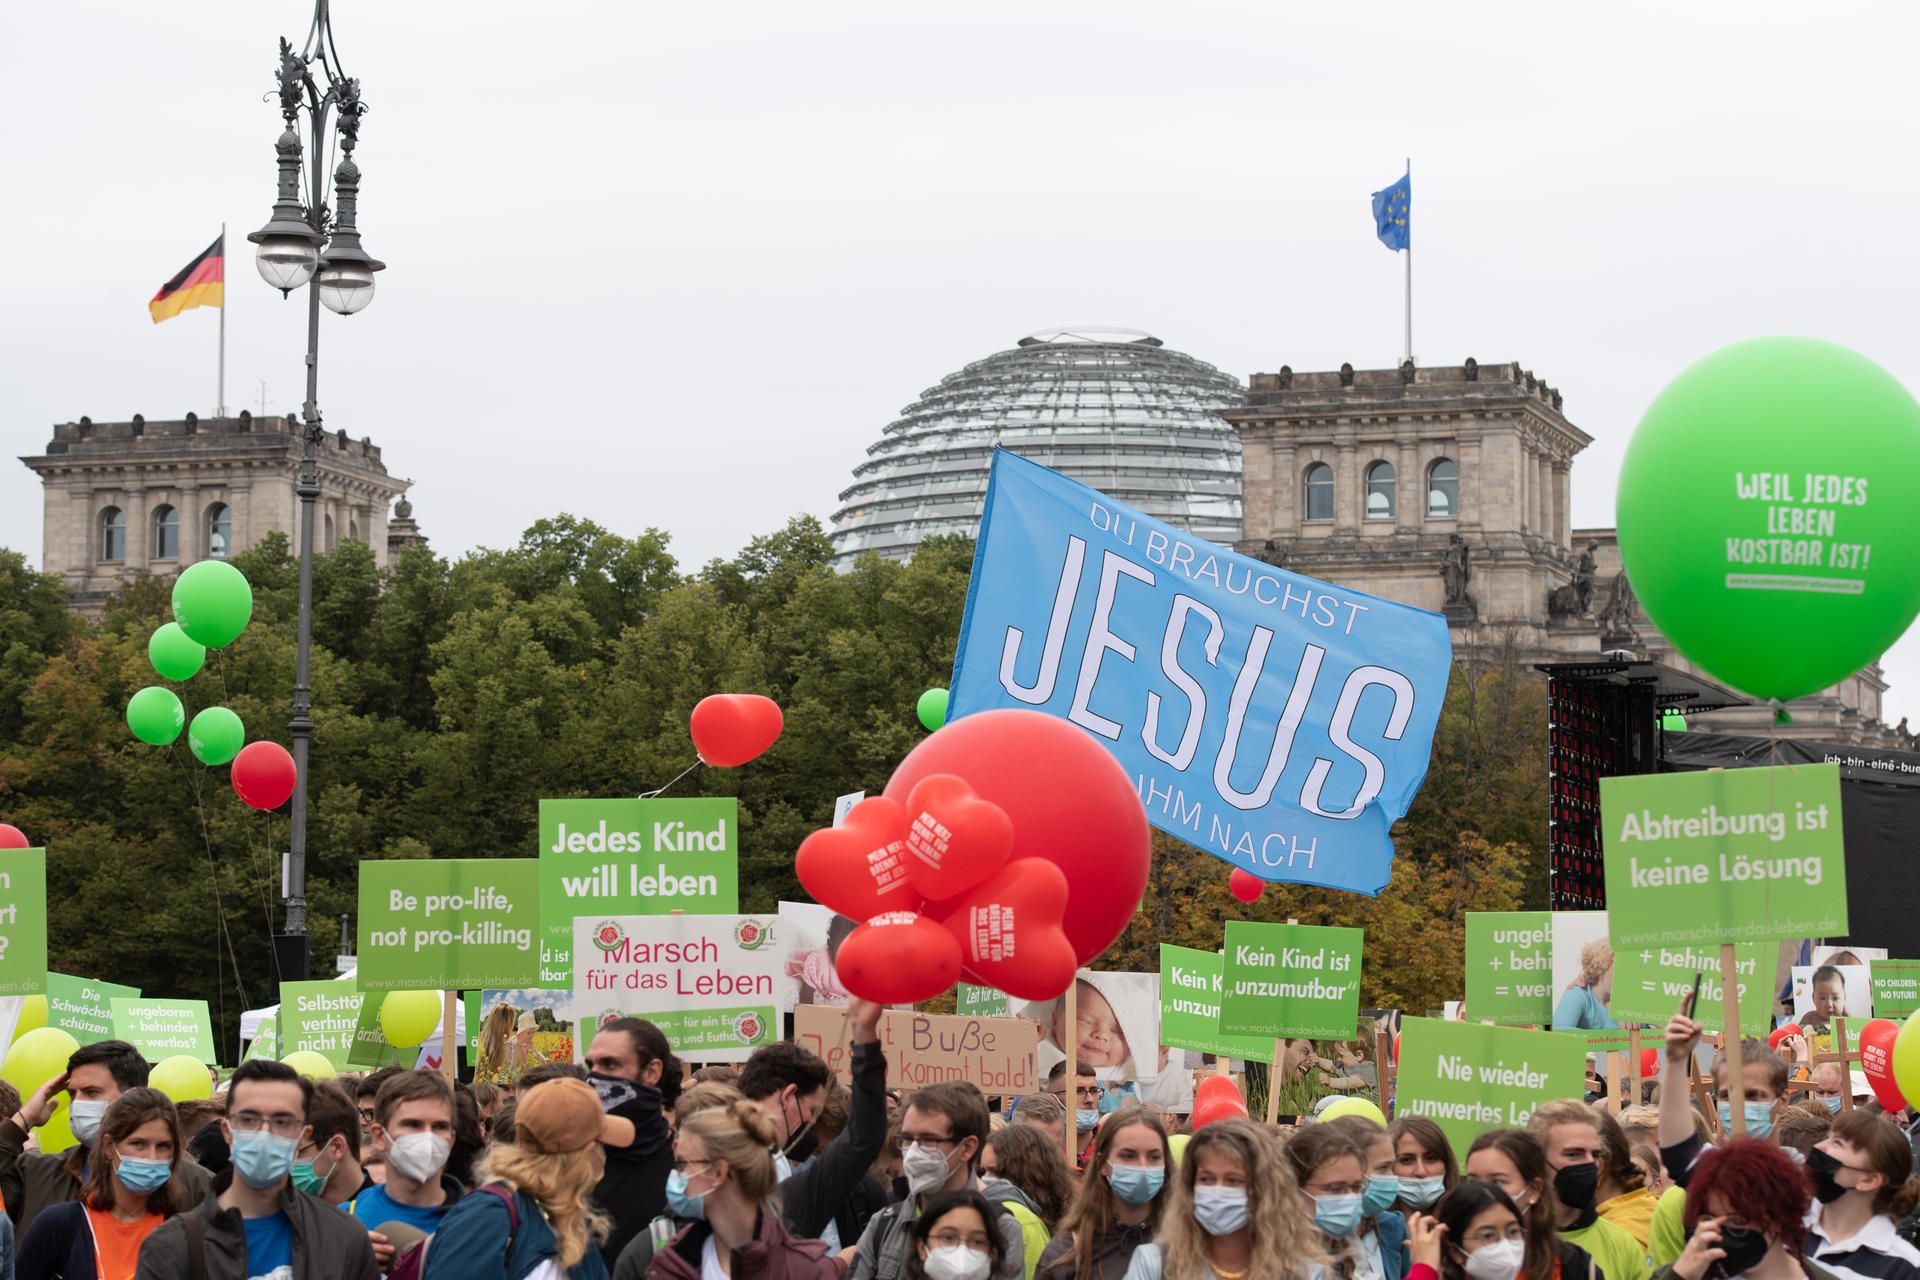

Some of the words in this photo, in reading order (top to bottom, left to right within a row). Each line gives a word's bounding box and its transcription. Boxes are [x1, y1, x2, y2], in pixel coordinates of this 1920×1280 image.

[1736, 472, 1794, 502] WEIL
[1802, 473, 1868, 506] JEDES
[1767, 505, 1836, 537] LEBEN
[1726, 537, 1822, 566] KOSTBAR
[1829, 543, 1872, 570] IST!
[1089, 501, 1135, 547] DU
[1146, 530, 1369, 636] BRAUCHST
[999, 534, 1415, 820] JESUS
[1137, 773, 1202, 832] IHM
[1209, 813, 1318, 870] NACH
[1620, 804, 1786, 842] Abtreibung
[1796, 802, 1829, 830] ist
[551, 820, 642, 854] Jedes
[654, 819, 726, 852] Kind
[561, 864, 618, 898] will
[630, 863, 718, 897] leben
[1630, 856, 1710, 888] keine
[1719, 853, 1823, 886] Lösung
[389, 888, 418, 912] Be
[425, 886, 514, 918] pro-life,
[370, 926, 407, 947] not
[414, 921, 532, 952] pro-killing
[604, 936, 718, 964] Marsch
[1493, 923, 1552, 949] ungeb
[555, 949, 569, 962] ist
[1236, 944, 1276, 968] Kein
[1281, 947, 1324, 970] Kind
[1329, 950, 1351, 972] ist
[586, 969, 618, 990] für
[626, 969, 668, 990] das
[676, 968, 774, 996] Leben
[1172, 966, 1206, 990] Kein
[1874, 979, 1886, 988] NO
[1887, 978, 1917, 988] CHILDREN
[82, 988, 101, 1002] Die
[1880, 990, 1892, 999] NO
[60, 1016, 108, 1035] schützen
[128, 1005, 194, 1019] ungeboren
[140, 1020, 198, 1034] behindert
[684, 1032, 704, 1043] und
[912, 1017, 997, 1055] Buße
[146, 1037, 197, 1049] wertlos?
[298, 1034, 336, 1051] nicht
[900, 1050, 968, 1085] kommt
[980, 1053, 1034, 1089] bald!
[1436, 1055, 1473, 1082] Nie
[1479, 1061, 1548, 1089] wieder
